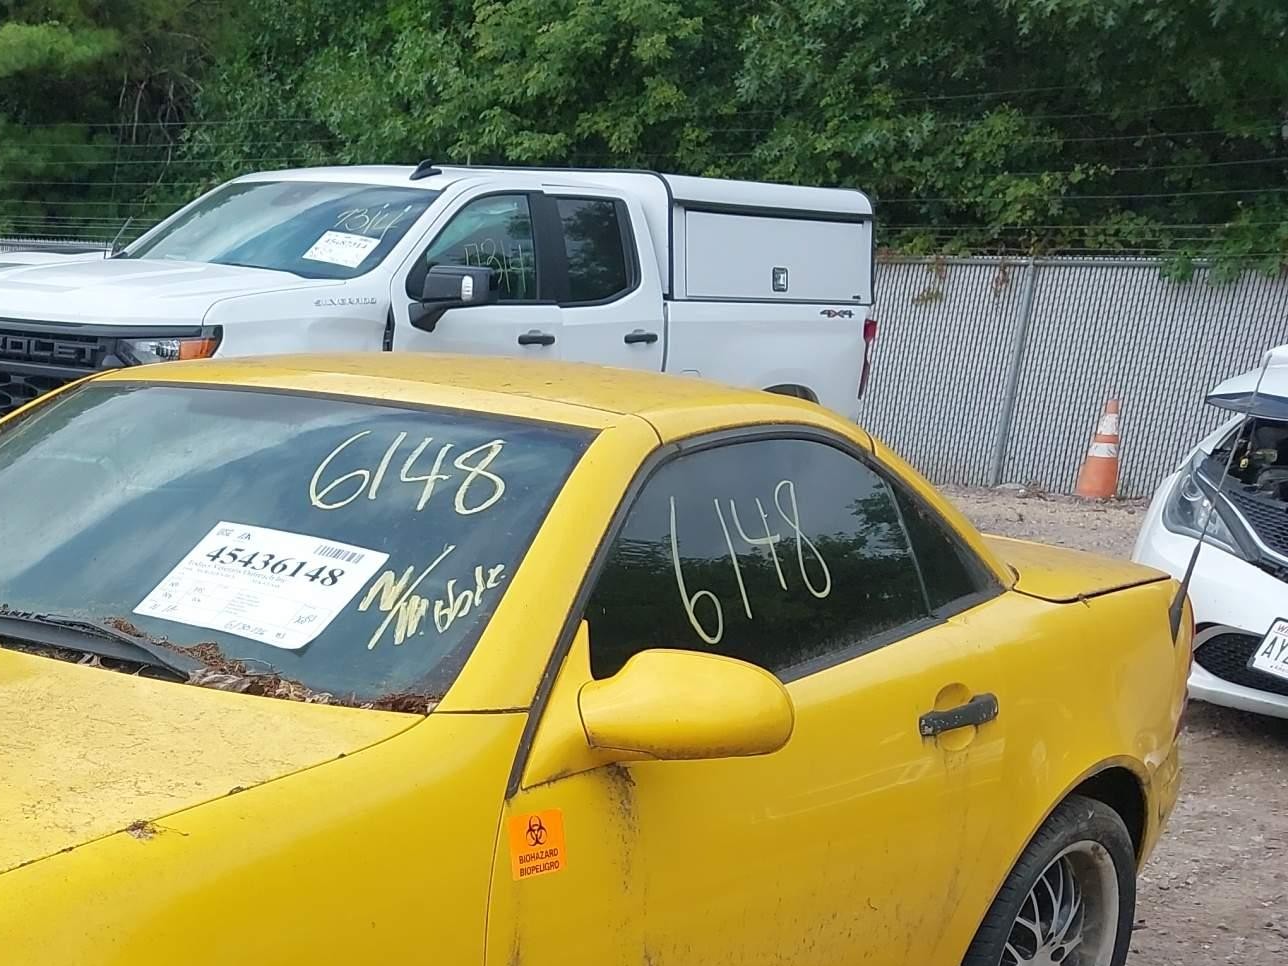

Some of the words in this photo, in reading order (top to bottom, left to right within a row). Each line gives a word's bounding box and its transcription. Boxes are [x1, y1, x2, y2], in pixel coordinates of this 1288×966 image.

[310, 430, 508, 516] 6148
[205, 545, 346, 588] 45436148
[670, 480, 832, 645] 6148
[519, 848, 559, 864] BIOHAZARD
[520, 860, 560, 877] BIOPELIGRO
